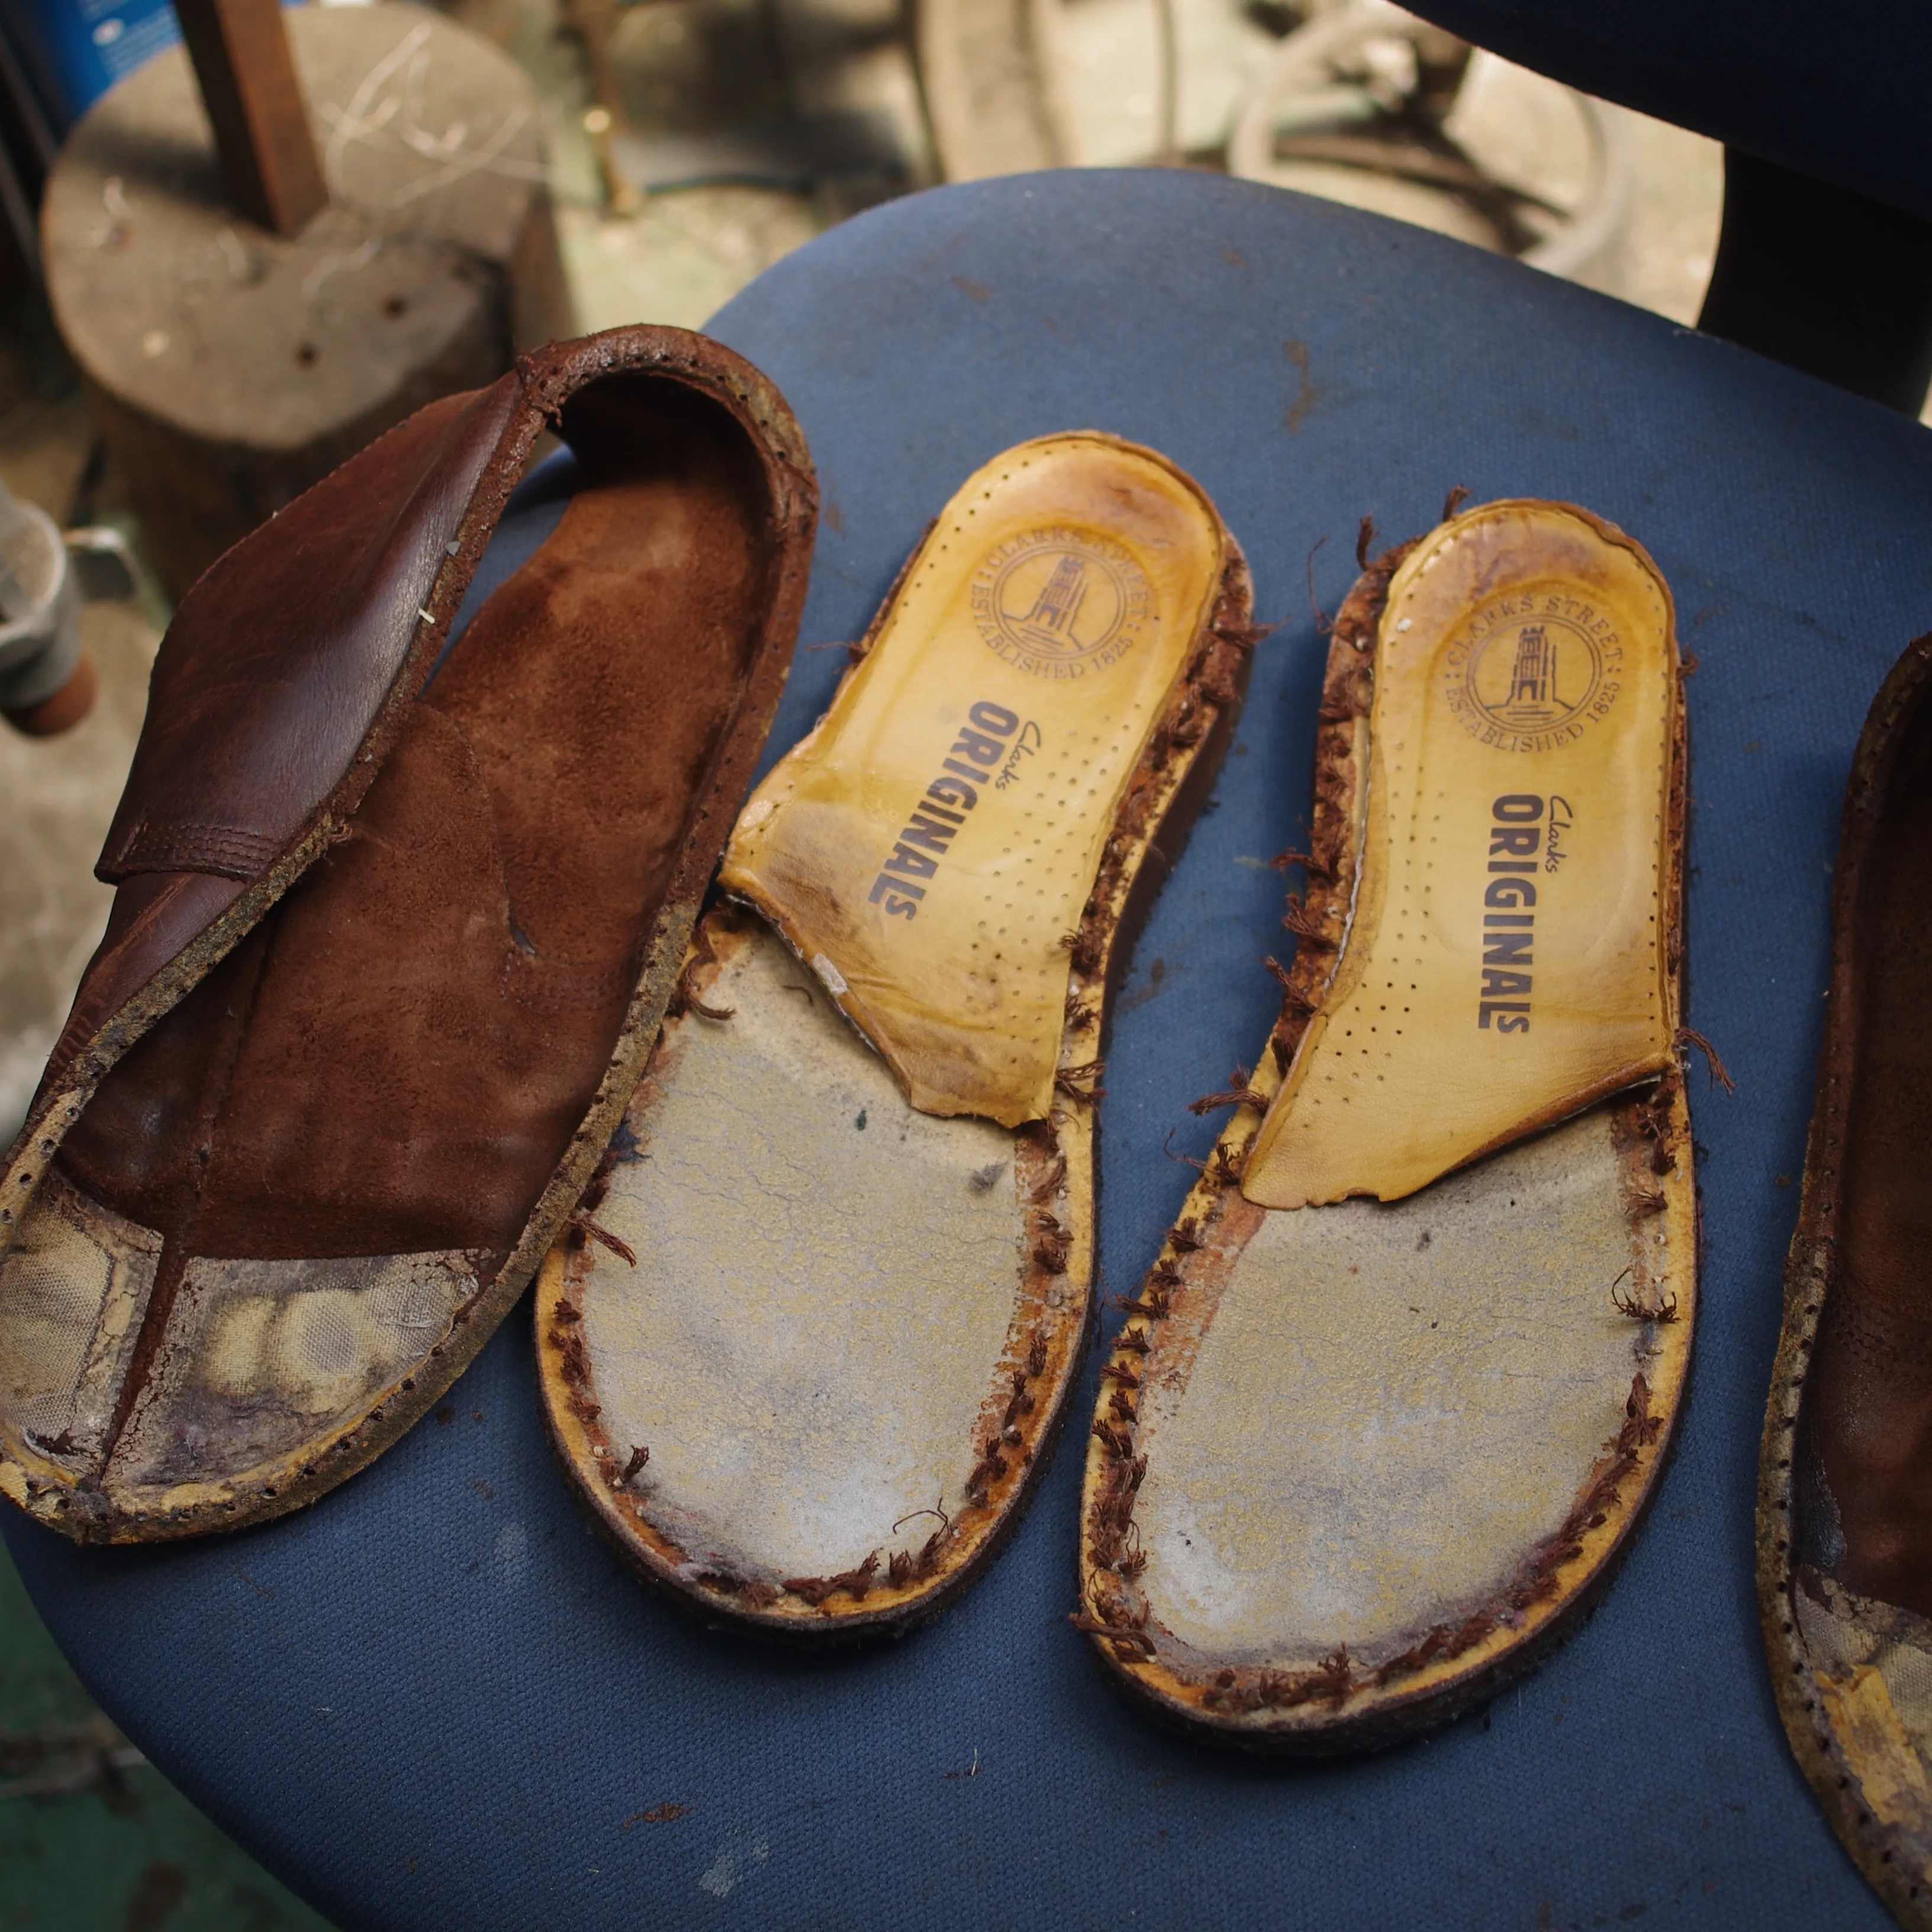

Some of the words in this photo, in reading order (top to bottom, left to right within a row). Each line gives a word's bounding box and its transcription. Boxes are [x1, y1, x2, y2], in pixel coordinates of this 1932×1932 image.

[971, 583, 1085, 679] ESTABLISHED
[1091, 636, 1133, 671] 1825
[1447, 594, 1533, 666] CLARKS
[1545, 595, 1624, 661] STREET
[995, 720, 1042, 791] Clarks
[1445, 687, 1584, 753] ESTABLISHED
[1586, 682, 1621, 724] 1825
[868, 701, 1019, 921] ORIGINALS
[1545, 795, 1573, 874] Clarks
[1478, 794, 1544, 1033] ORIGINALS
